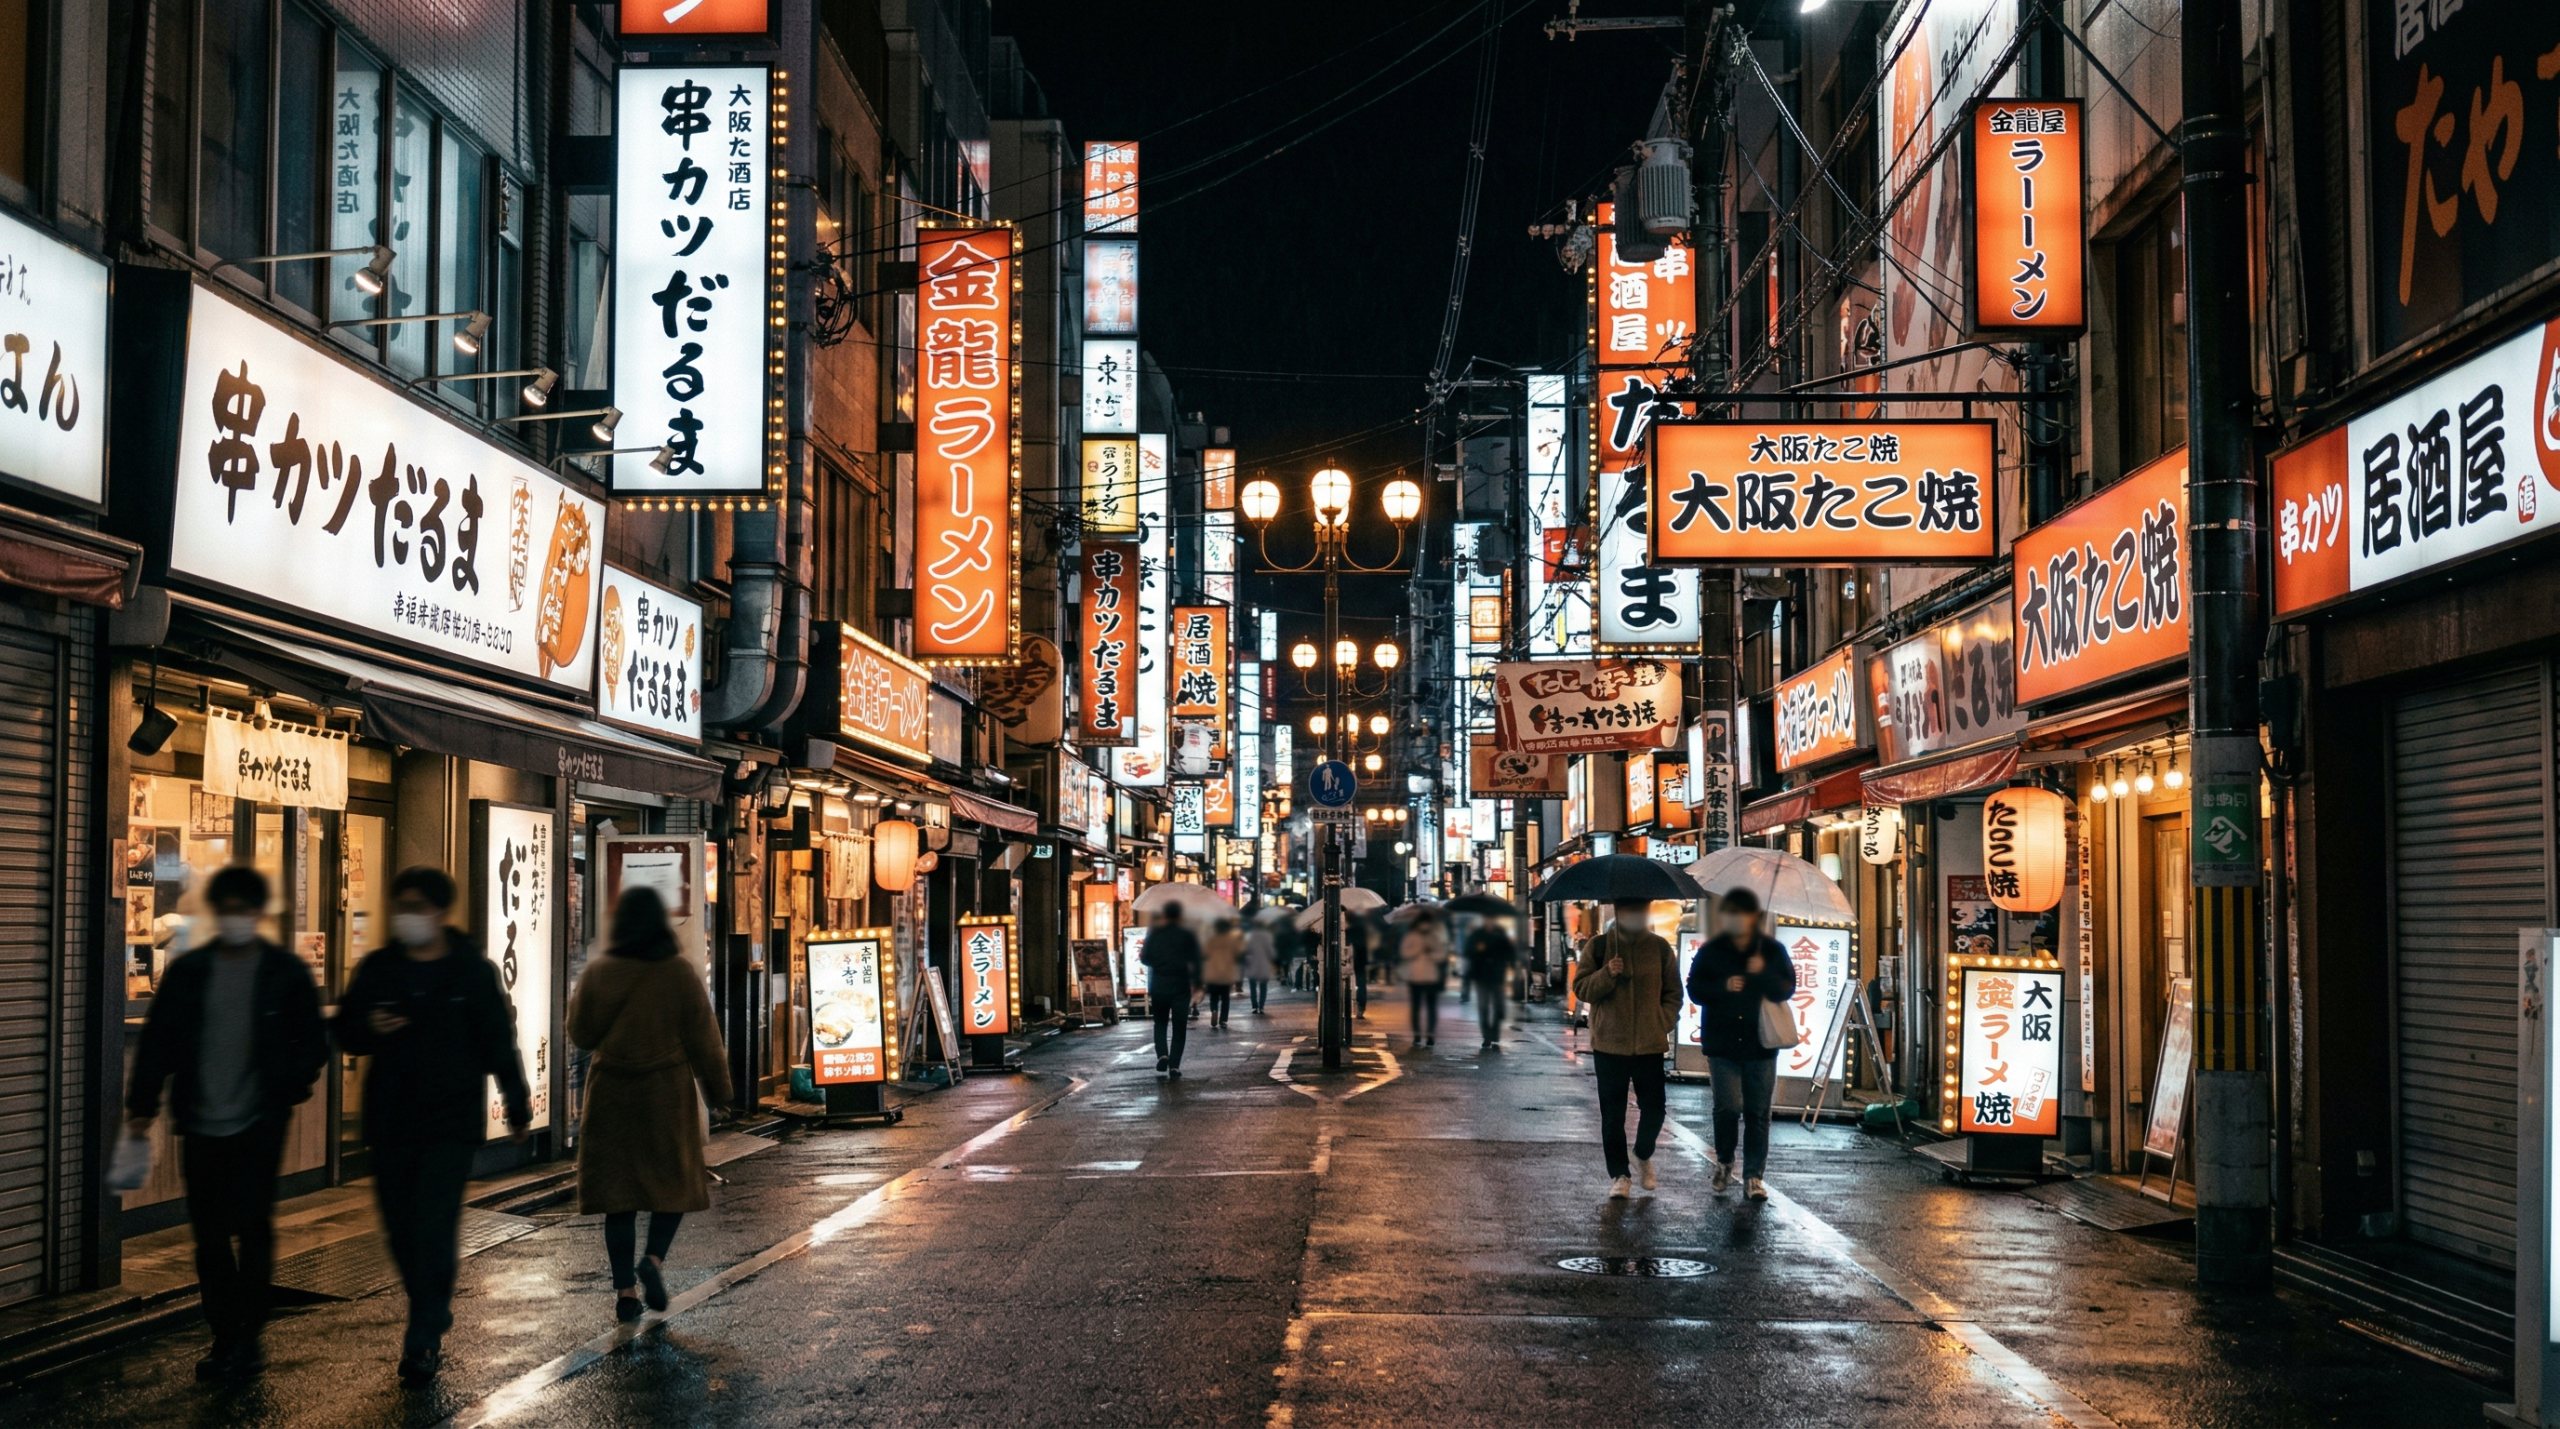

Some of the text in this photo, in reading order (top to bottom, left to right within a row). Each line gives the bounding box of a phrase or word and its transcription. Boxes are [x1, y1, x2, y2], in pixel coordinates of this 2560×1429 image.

[728, 84, 752, 211] 大阪た酒店
[652, 79, 729, 476] 串カツだるま
[208, 359, 484, 597] 串カツだるま
[926, 241, 1001, 645] 金龍ラーメン
[1669, 469, 1981, 533] 大阪たこ焼
[1750, 434, 1900, 463] 大阪たこ焼
[2363, 384, 2508, 559] 居酒屋
[2021, 499, 2181, 674] 大阪たこ焼
[2280, 483, 2342, 565] 串カツ
[637, 591, 679, 650] 串カツ
[2022, 980, 2053, 1042] 大阪
